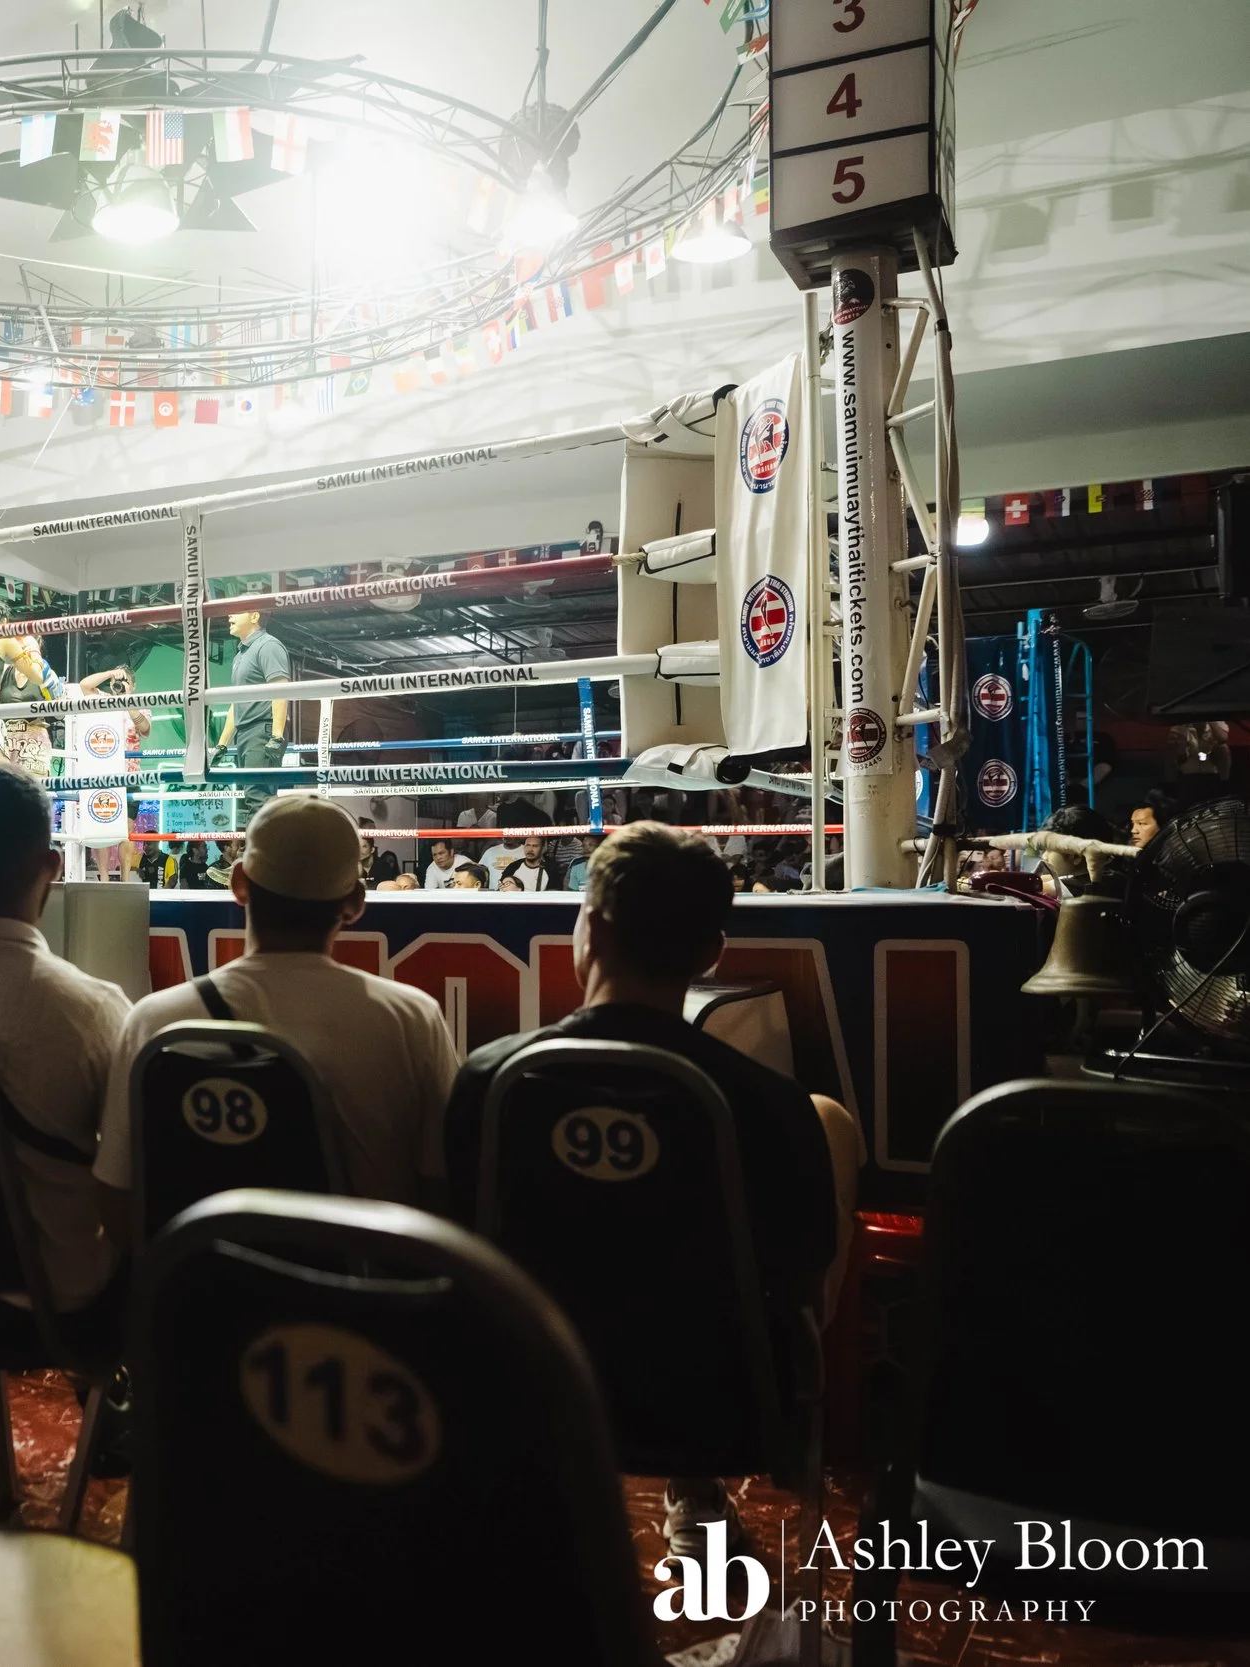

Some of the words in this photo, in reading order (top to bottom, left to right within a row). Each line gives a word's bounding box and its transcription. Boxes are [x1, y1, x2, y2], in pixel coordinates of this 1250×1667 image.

[832, 0, 865, 33] 3
[826, 72, 862, 119] 4
[831, 156, 866, 204] 5
[316, 471, 367, 491] SAMUI
[371, 447, 498, 480] INTERNATIONAL
[33, 521, 74, 537] SAMUI
[76, 506, 178, 529] INTERNATIONAL
[842, 329, 867, 704] www.samuimuaythaitickets.com
[186, 525, 199, 578] SAMUI
[274, 590, 323, 608] SAMUI
[328, 575, 456, 600] INTERNATIONAL
[31, 613, 132, 634] INTERNATIONAL
[186, 582, 202, 706] INTERNATIONAL
[340, 675, 395, 693] SAMUI
[400, 667, 539, 690] INTERNATIONAL
[30, 700, 74, 714] SAMUI
[77, 694, 184, 711] INTERNATIONAL
[583, 707, 594, 738] SAMUI
[331, 741, 381, 749] ERNATIONAL
[461, 736, 492, 745] SAMUI
[494, 734, 560, 743] INTERNATIONAL
[59, 772, 166, 788] INTERNATIONAL
[316, 767, 370, 782] SAMUI
[371, 765, 508, 782] INTERNATIONAL
[584, 739, 600, 810] INTETIONAL
[353, 787, 380, 795] SAMUI
[381, 785, 444, 794] INTERNATIONAL
[200, 831, 246, 839] INTERNATION
[358, 828, 419, 837] NTERNATIONAL
[533, 826, 591, 836] INTERNATIO
[701, 825, 736, 833] SAMUI
[737, 824, 813, 833] INTERNATIONA
[192, 1086, 255, 1135] 98
[564, 1115, 646, 1172] 99
[251, 1342, 425, 1467] 113
